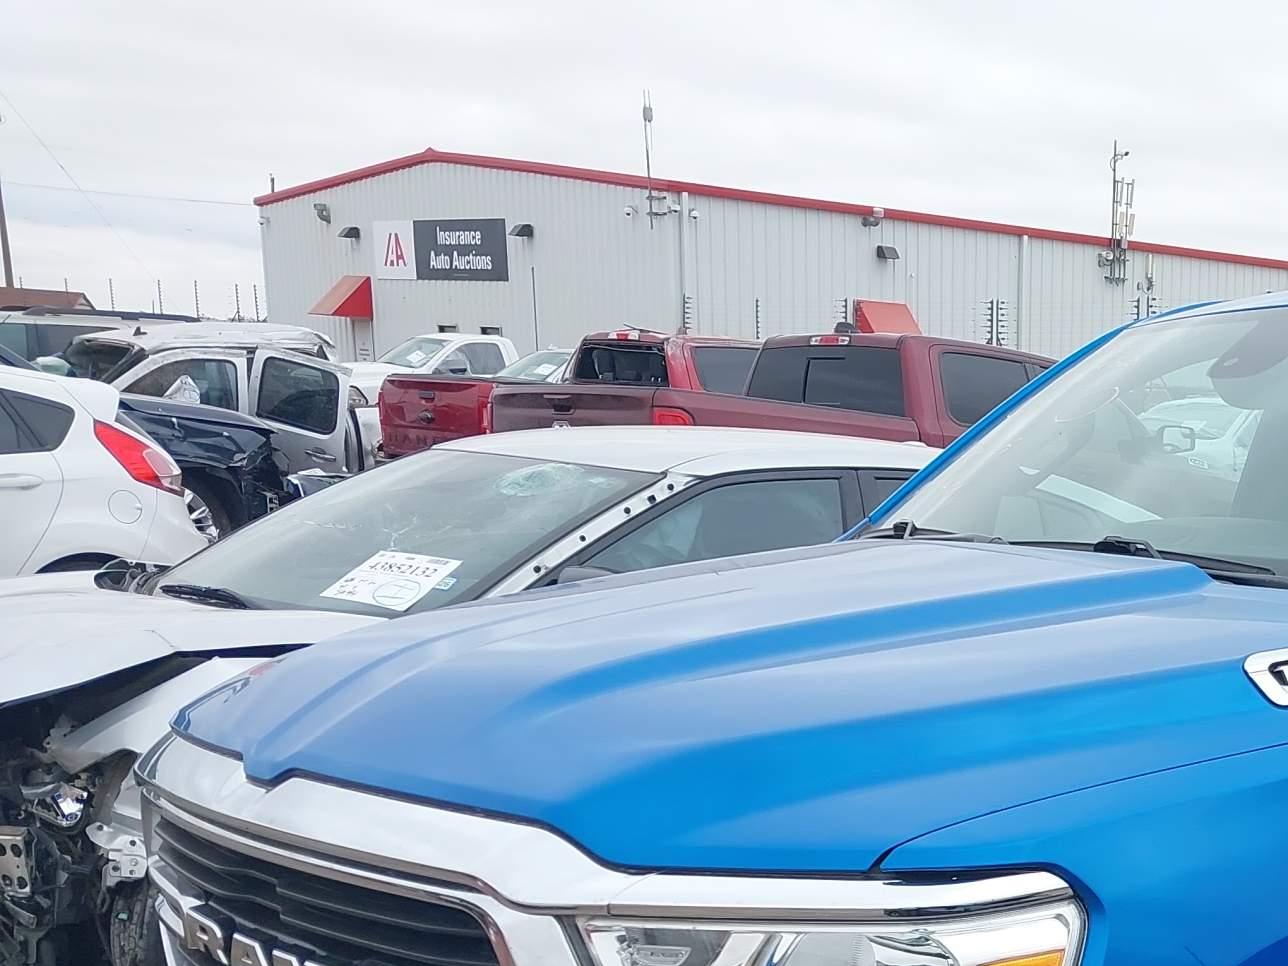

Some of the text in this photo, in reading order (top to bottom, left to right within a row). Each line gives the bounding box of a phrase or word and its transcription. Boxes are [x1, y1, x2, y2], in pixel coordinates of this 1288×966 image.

[436, 226, 482, 246] Insurance
[429, 249, 493, 271] Auto Auctions
[368, 560, 439, 578] 43852132
